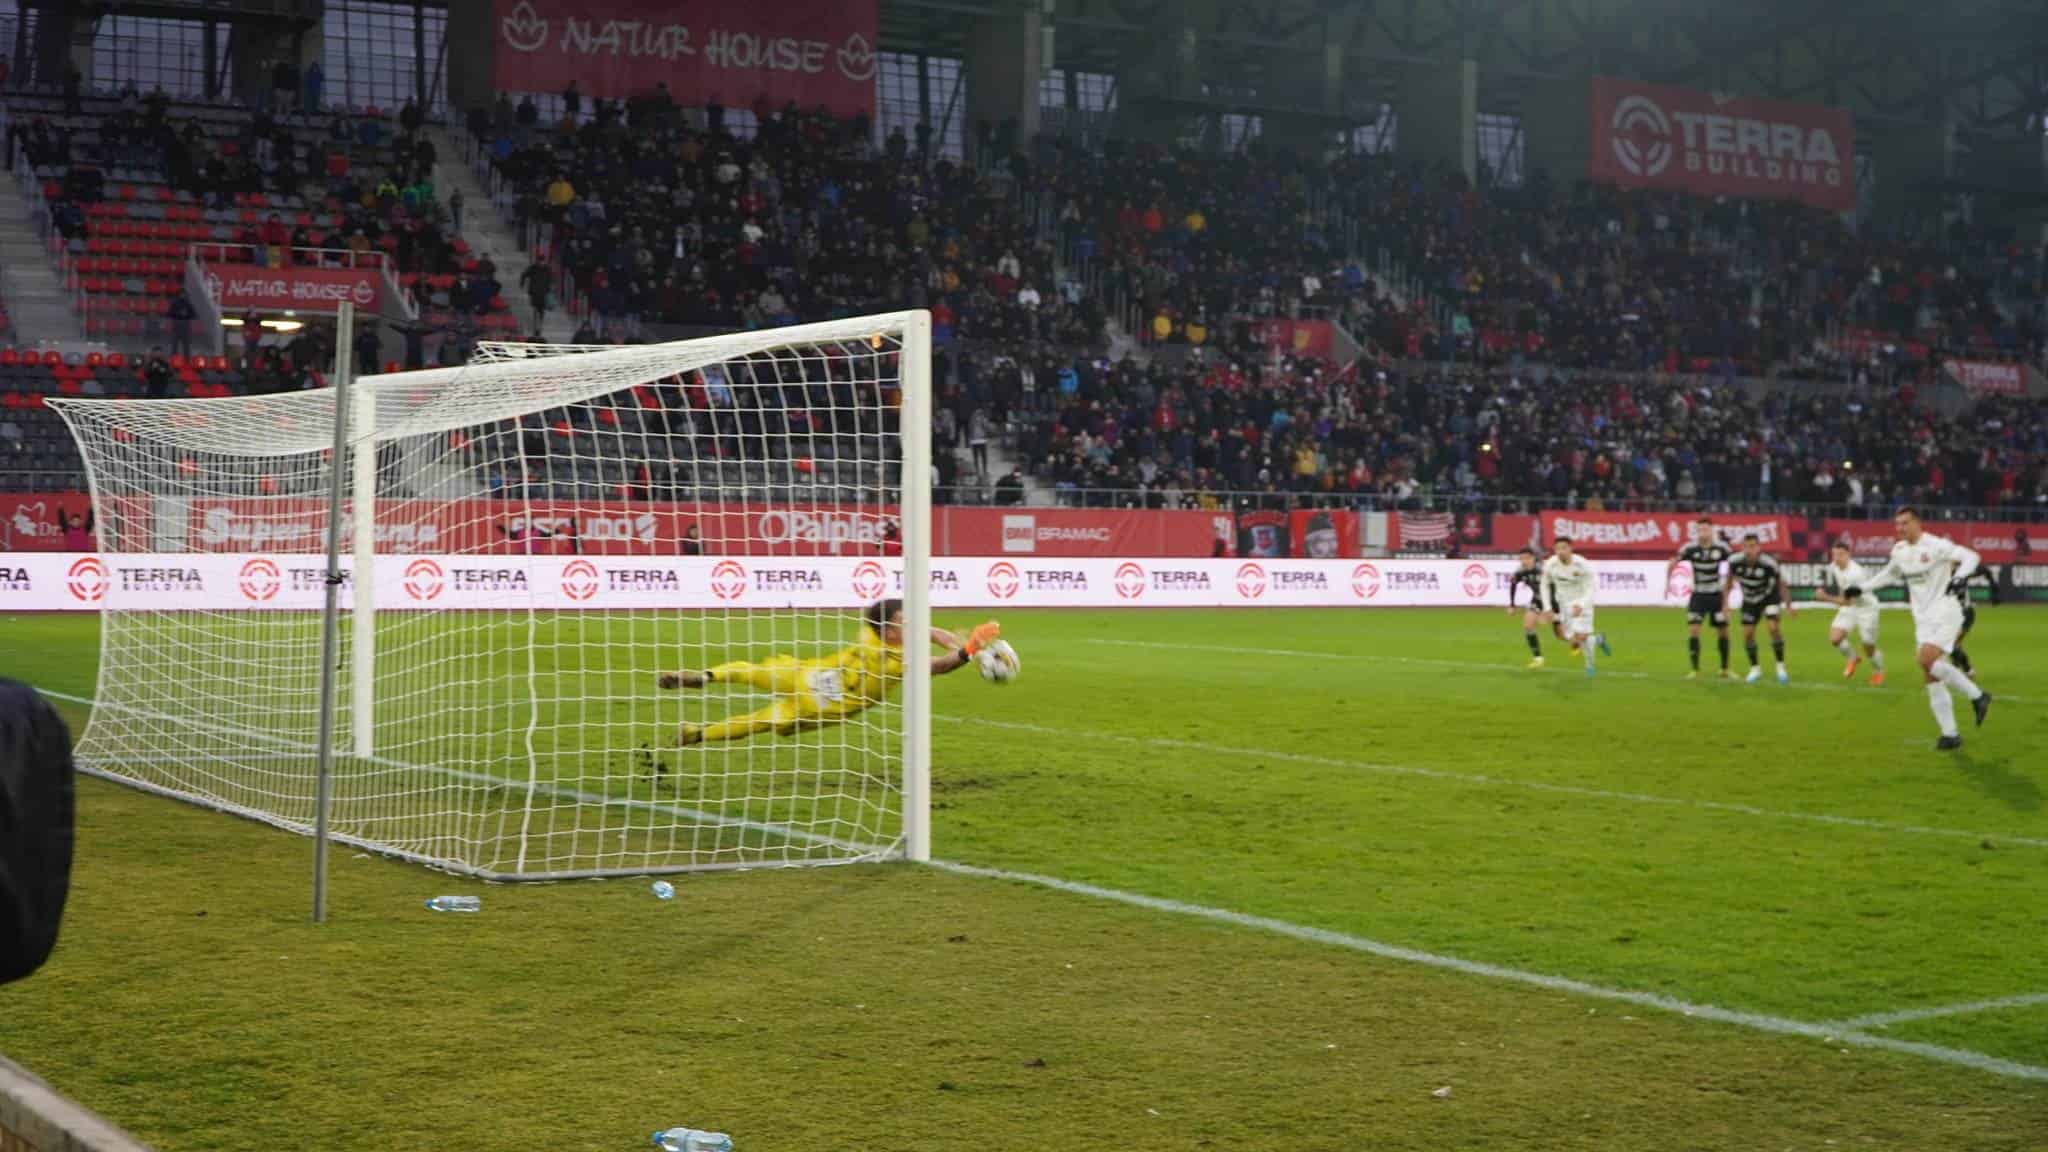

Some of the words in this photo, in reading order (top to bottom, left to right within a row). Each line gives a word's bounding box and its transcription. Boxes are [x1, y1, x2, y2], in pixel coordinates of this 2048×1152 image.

[560, 17, 696, 61] NATUR
[704, 28, 829, 73] HOUSE
[1672, 111, 1839, 163] TERRA
[1685, 151, 1841, 186] BUILDING
[227, 279, 288, 298] NATUR
[292, 281, 351, 300] HOUSE
[1037, 527, 1111, 541] BRAMAC
[1553, 516, 1662, 544] SUPERLIGA
[117, 568, 203, 582] TERRA
[451, 569, 528, 582] TERRA
[605, 569, 679, 582] TERRA
[752, 570, 823, 583] TERRA
[893, 570, 958, 582] TRA
[1025, 570, 1088, 583] TERRA
[1151, 571, 1210, 583] TERRA
[1271, 571, 1328, 583] TERRA
[1385, 571, 1440, 583] TERRA
